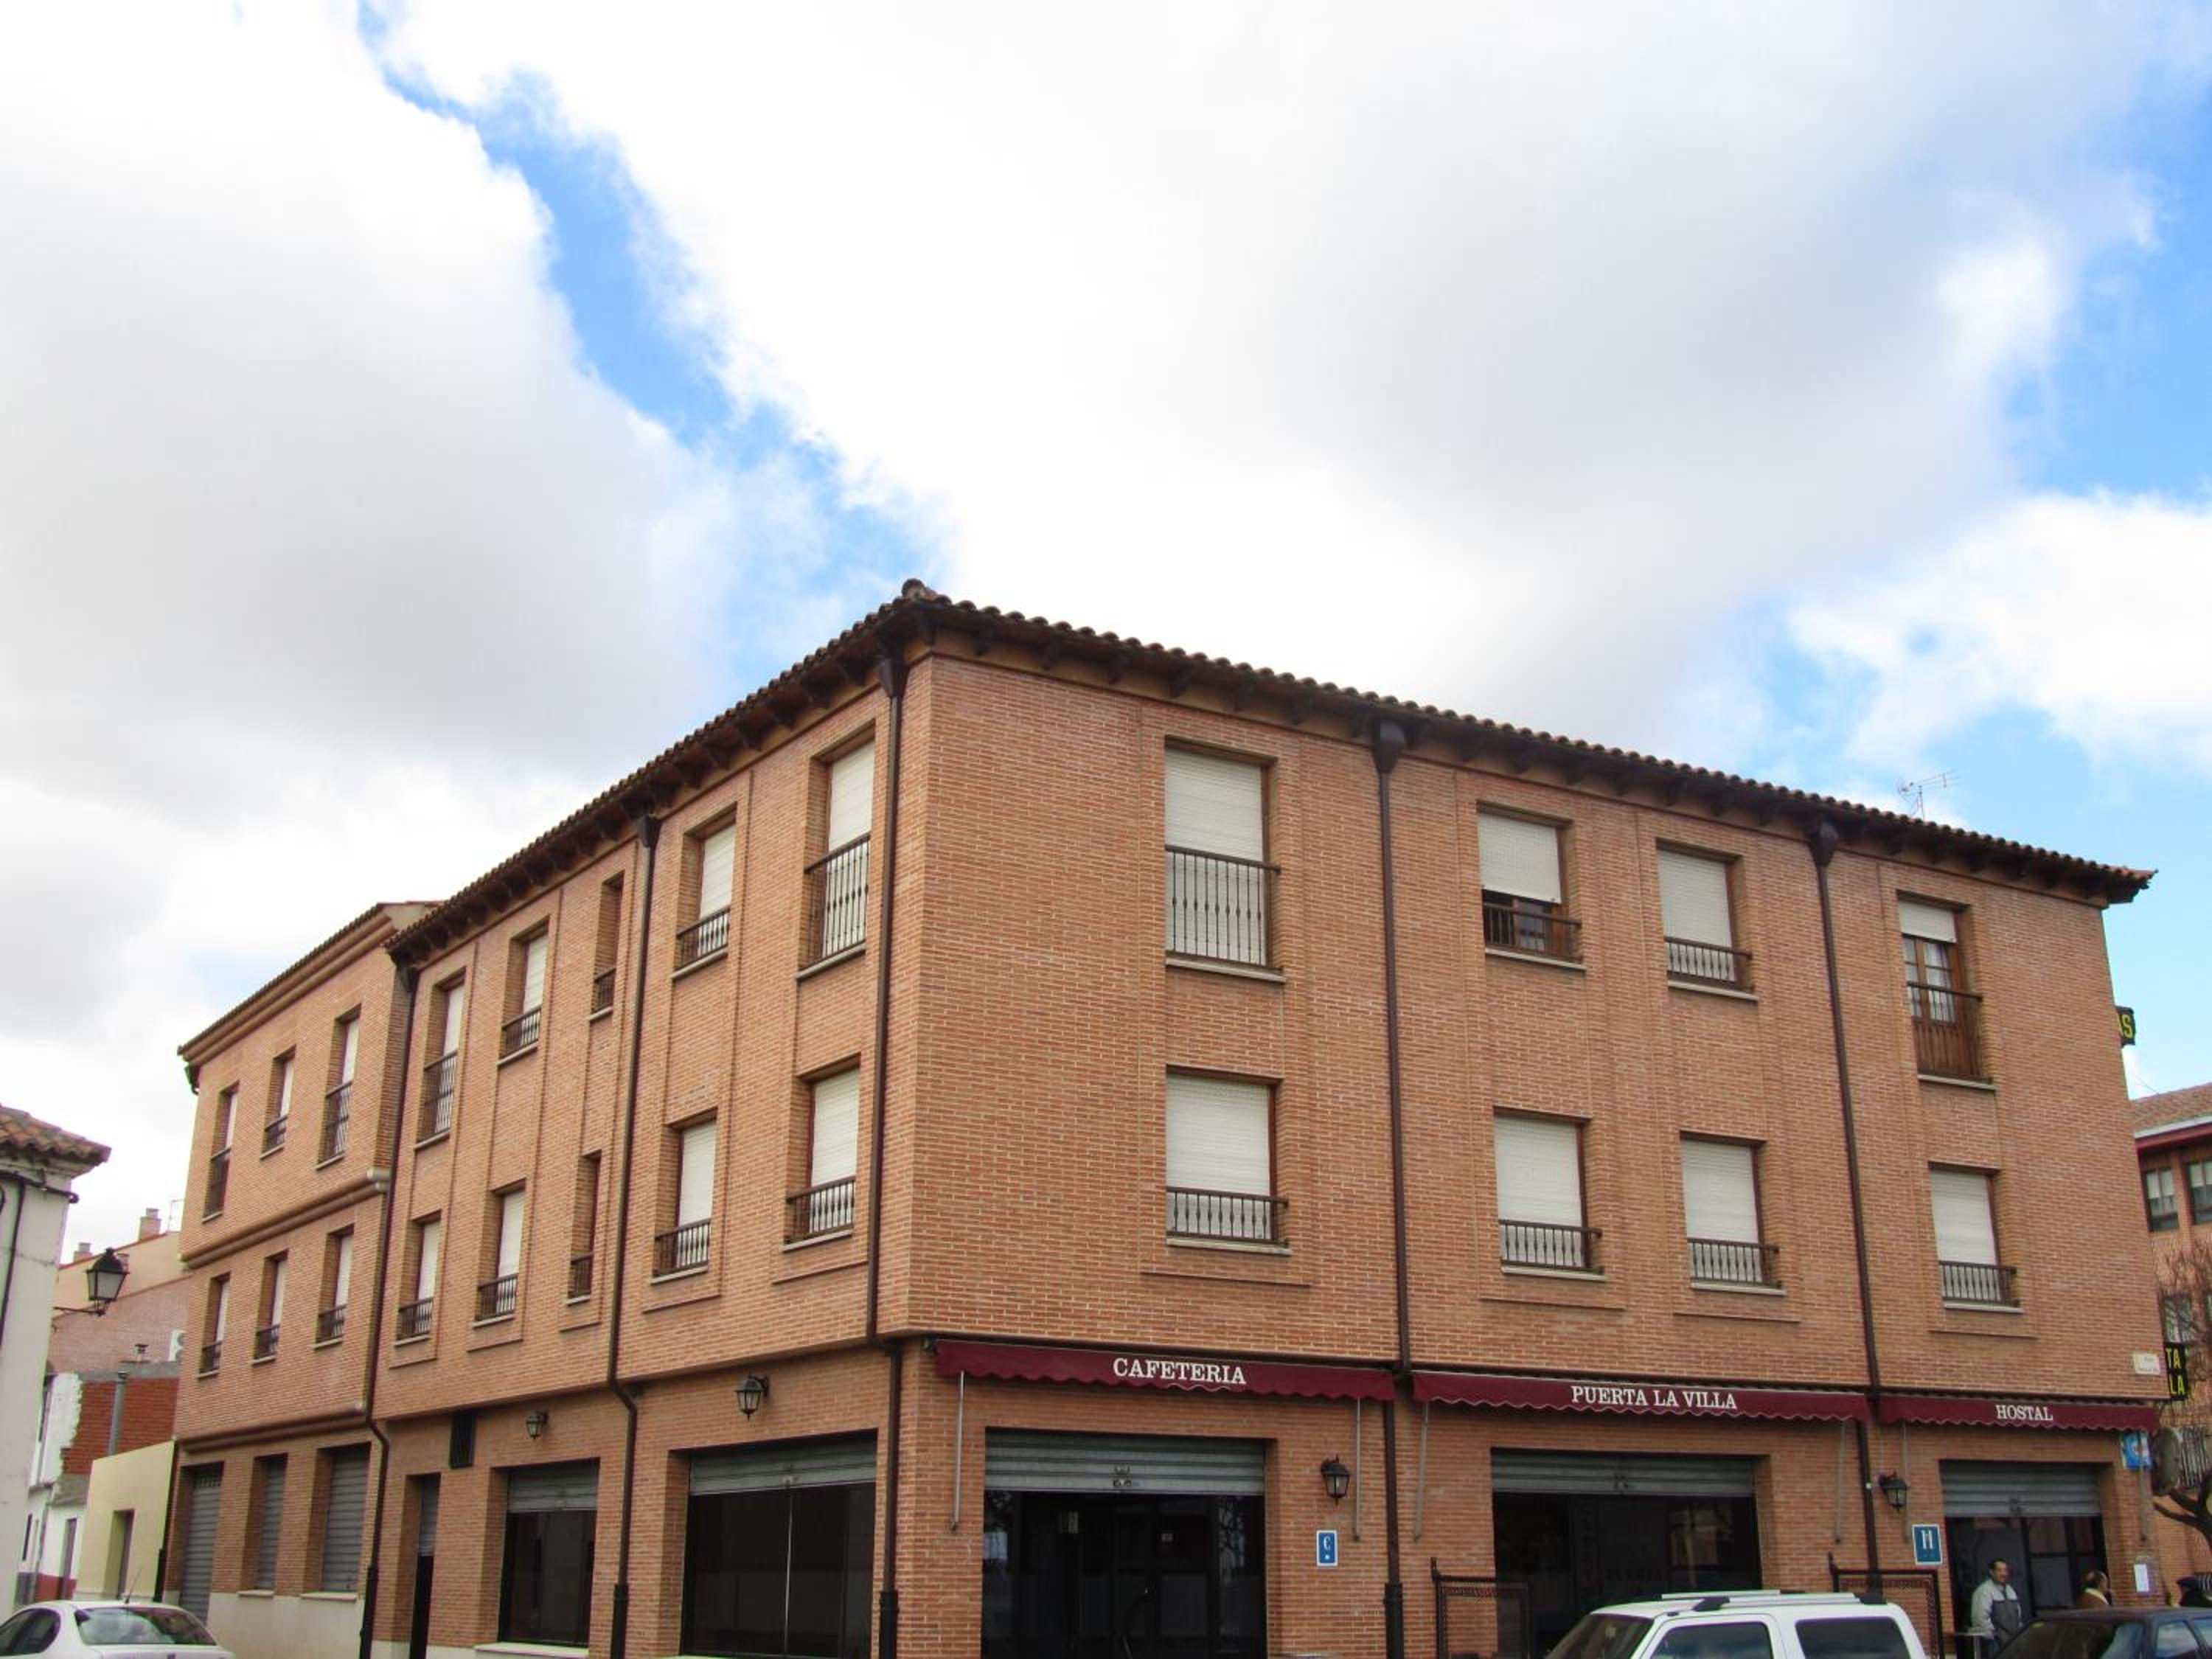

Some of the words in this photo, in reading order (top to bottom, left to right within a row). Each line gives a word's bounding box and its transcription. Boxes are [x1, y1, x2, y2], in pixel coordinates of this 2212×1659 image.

[1113, 1357, 1247, 1385] CAFETERIA
[1571, 1385, 1649, 1406] PUERTA
[1653, 1390, 1680, 1407] LA
[1682, 1391, 1738, 1410] VILLA
[1995, 1405, 2053, 1421] HOSTAL
